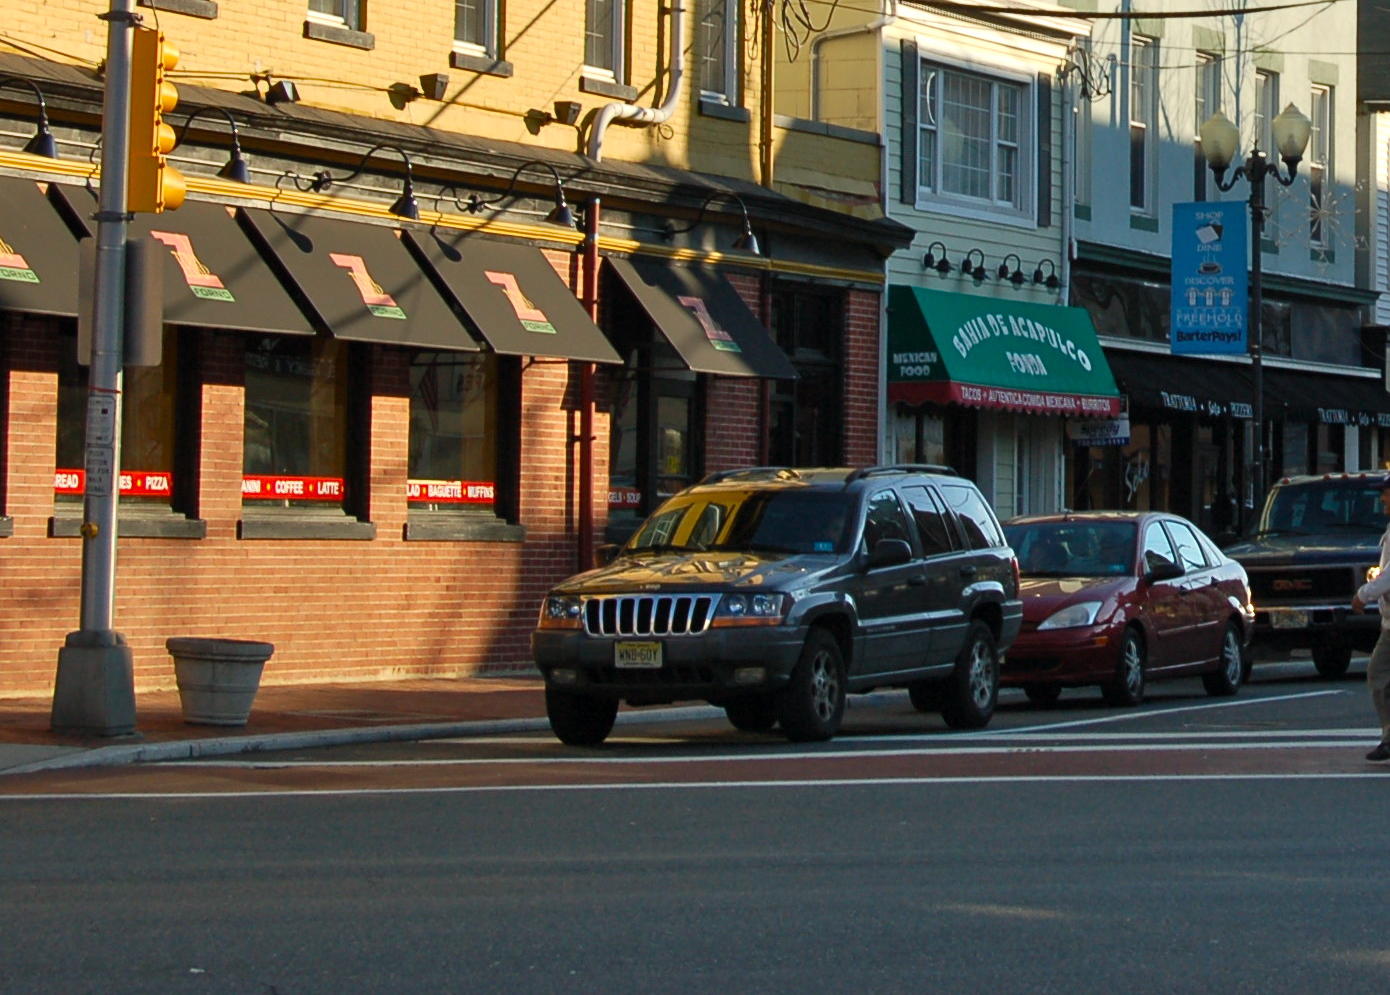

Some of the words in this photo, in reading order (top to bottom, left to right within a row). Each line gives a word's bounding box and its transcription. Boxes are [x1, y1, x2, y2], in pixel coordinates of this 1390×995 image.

[1195, 211, 1224, 220] SHOP
[1197, 244, 1222, 252] DINE
[1185, 276, 1234, 285] DISCOVER
[1176, 313, 1242, 324] FREEHOLD
[953, 316, 990, 359] BAHIA
[986, 313, 1009, 337] DE
[1008, 315, 1092, 371] ACAPULCO
[893, 352, 937, 364] MEXICAN
[1006, 351, 1048, 376] FONDA
[900, 365, 930, 376] FOOD
[961, 386, 981, 401] TACOS
[145, 476, 168, 490] PIZZA
[275, 480, 303, 494] COFFEE
[317, 481, 339, 495] LATTE
[428, 484, 461, 498] BAGUETTE
[468, 486, 494, 498] MUFFINS
